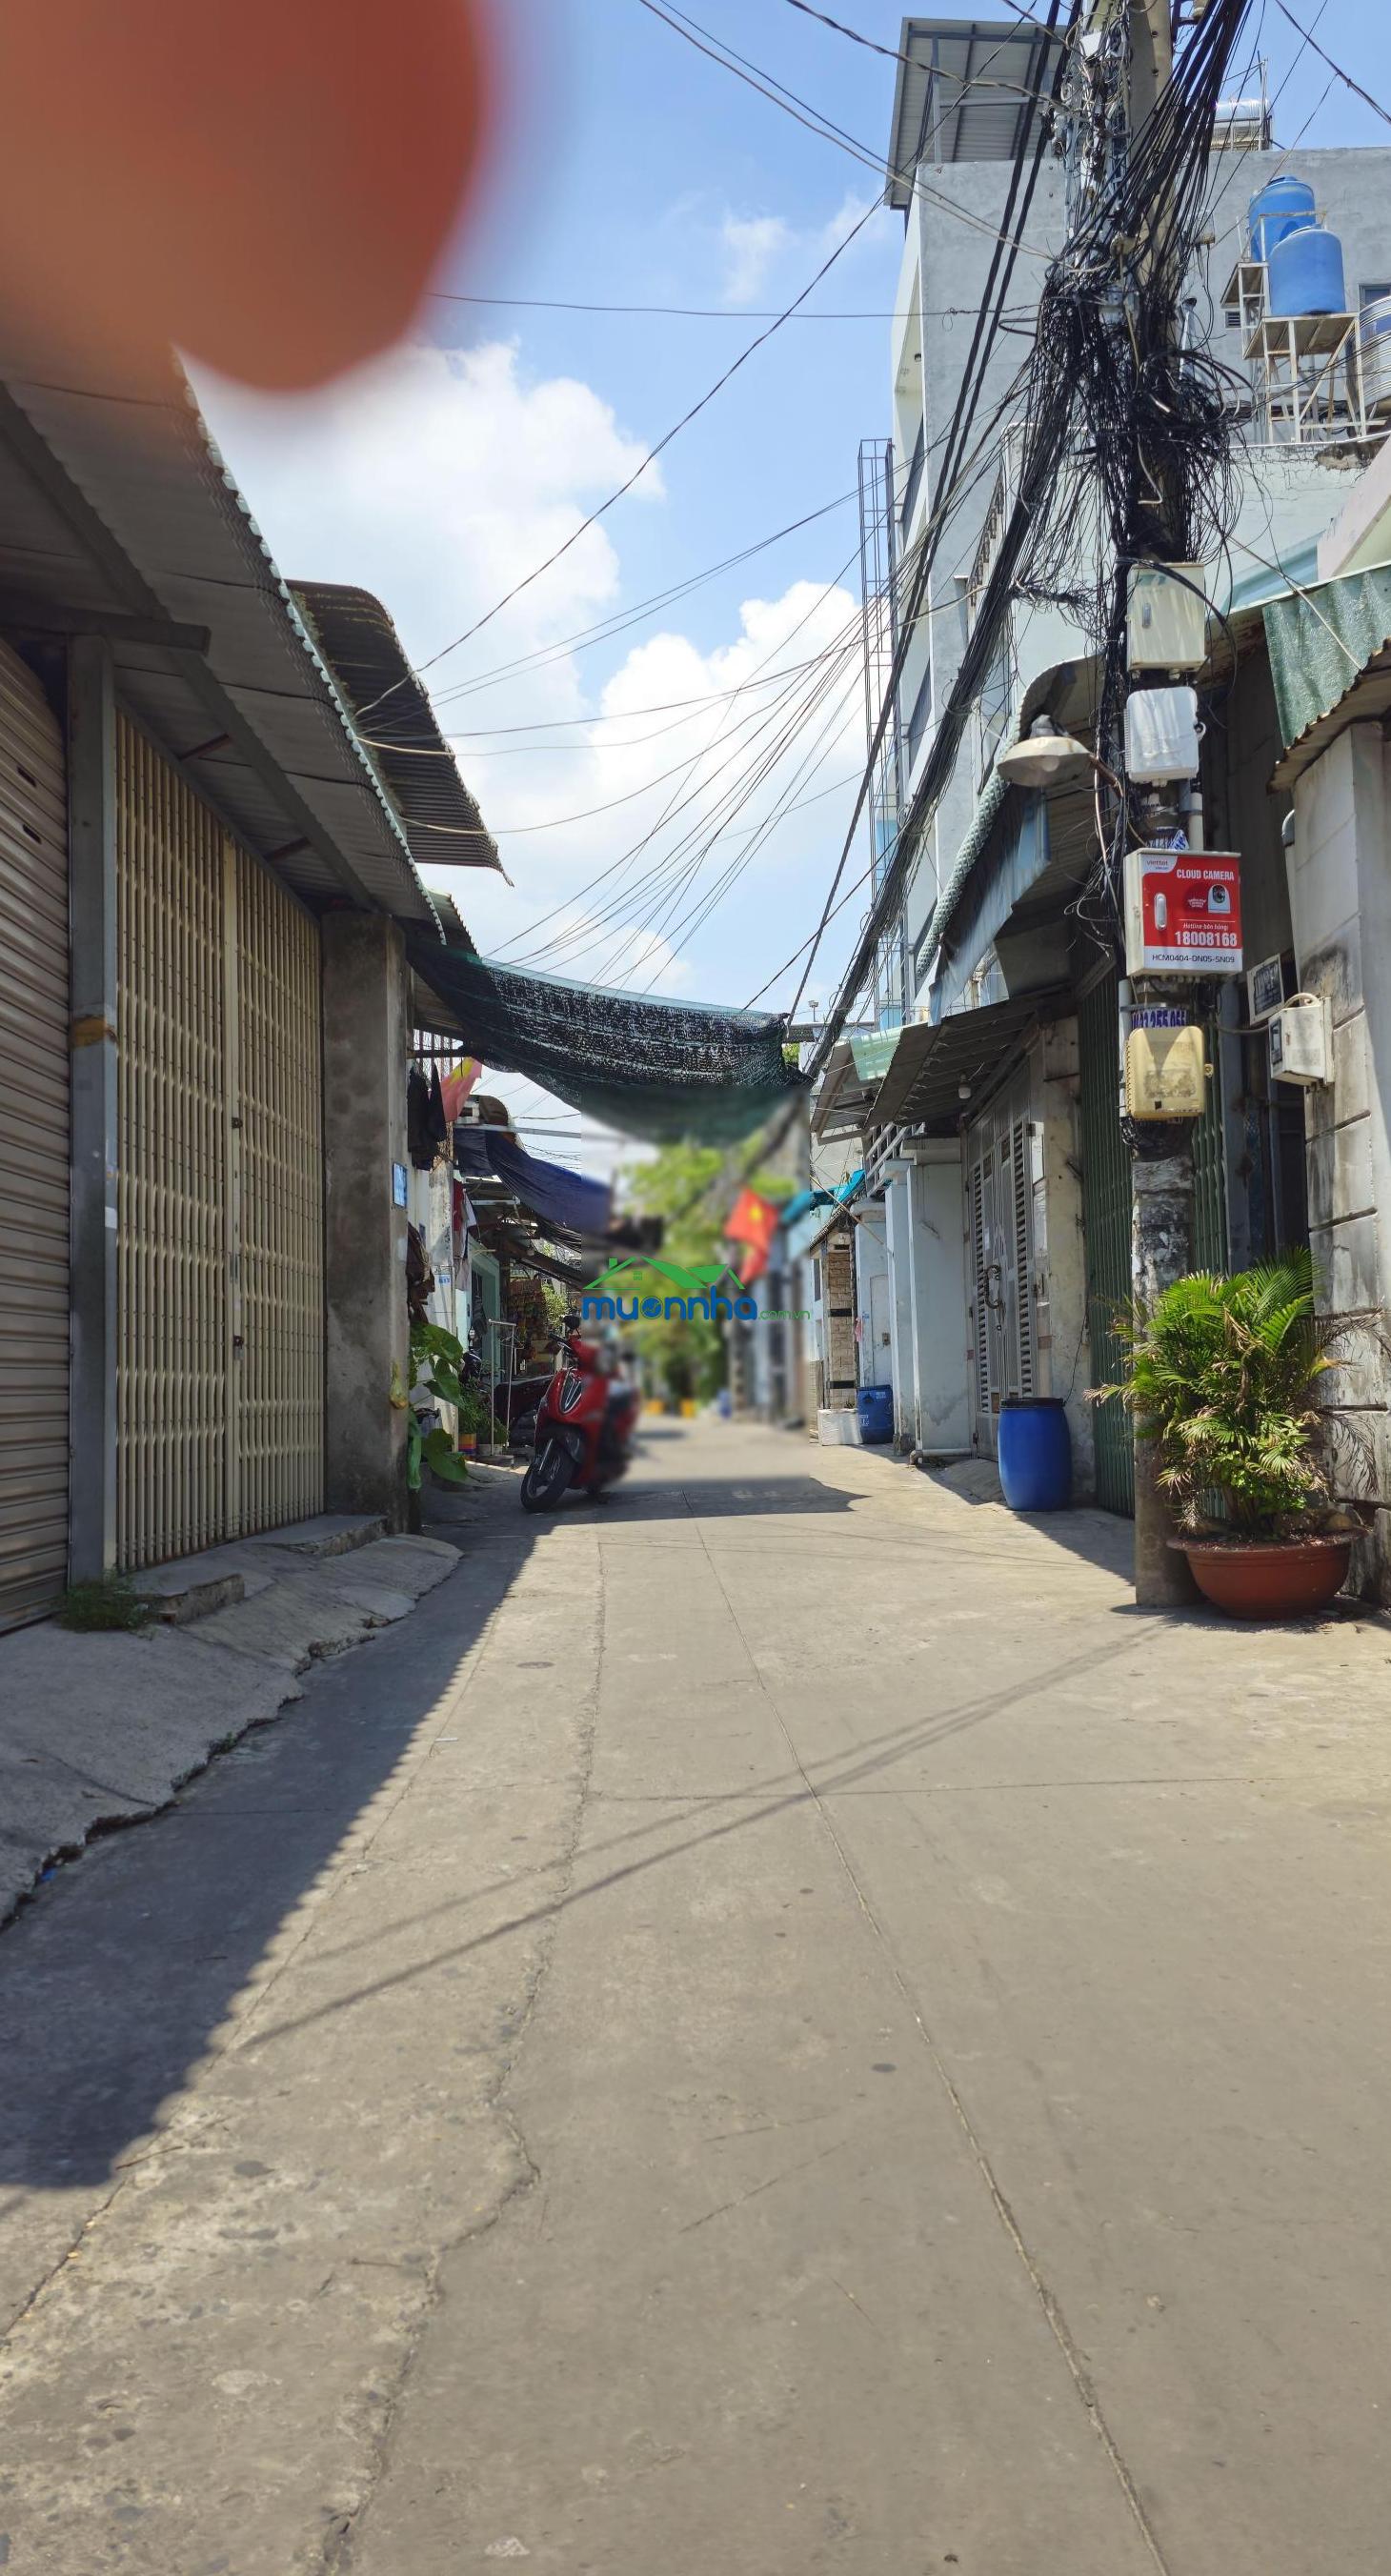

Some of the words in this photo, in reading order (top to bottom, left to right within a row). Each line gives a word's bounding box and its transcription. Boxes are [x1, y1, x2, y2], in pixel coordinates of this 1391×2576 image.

[1177, 869, 1201, 879] CLOUD
[1203, 870, 1235, 880] CAMERA
[1175, 931, 1238, 947] 18008168
